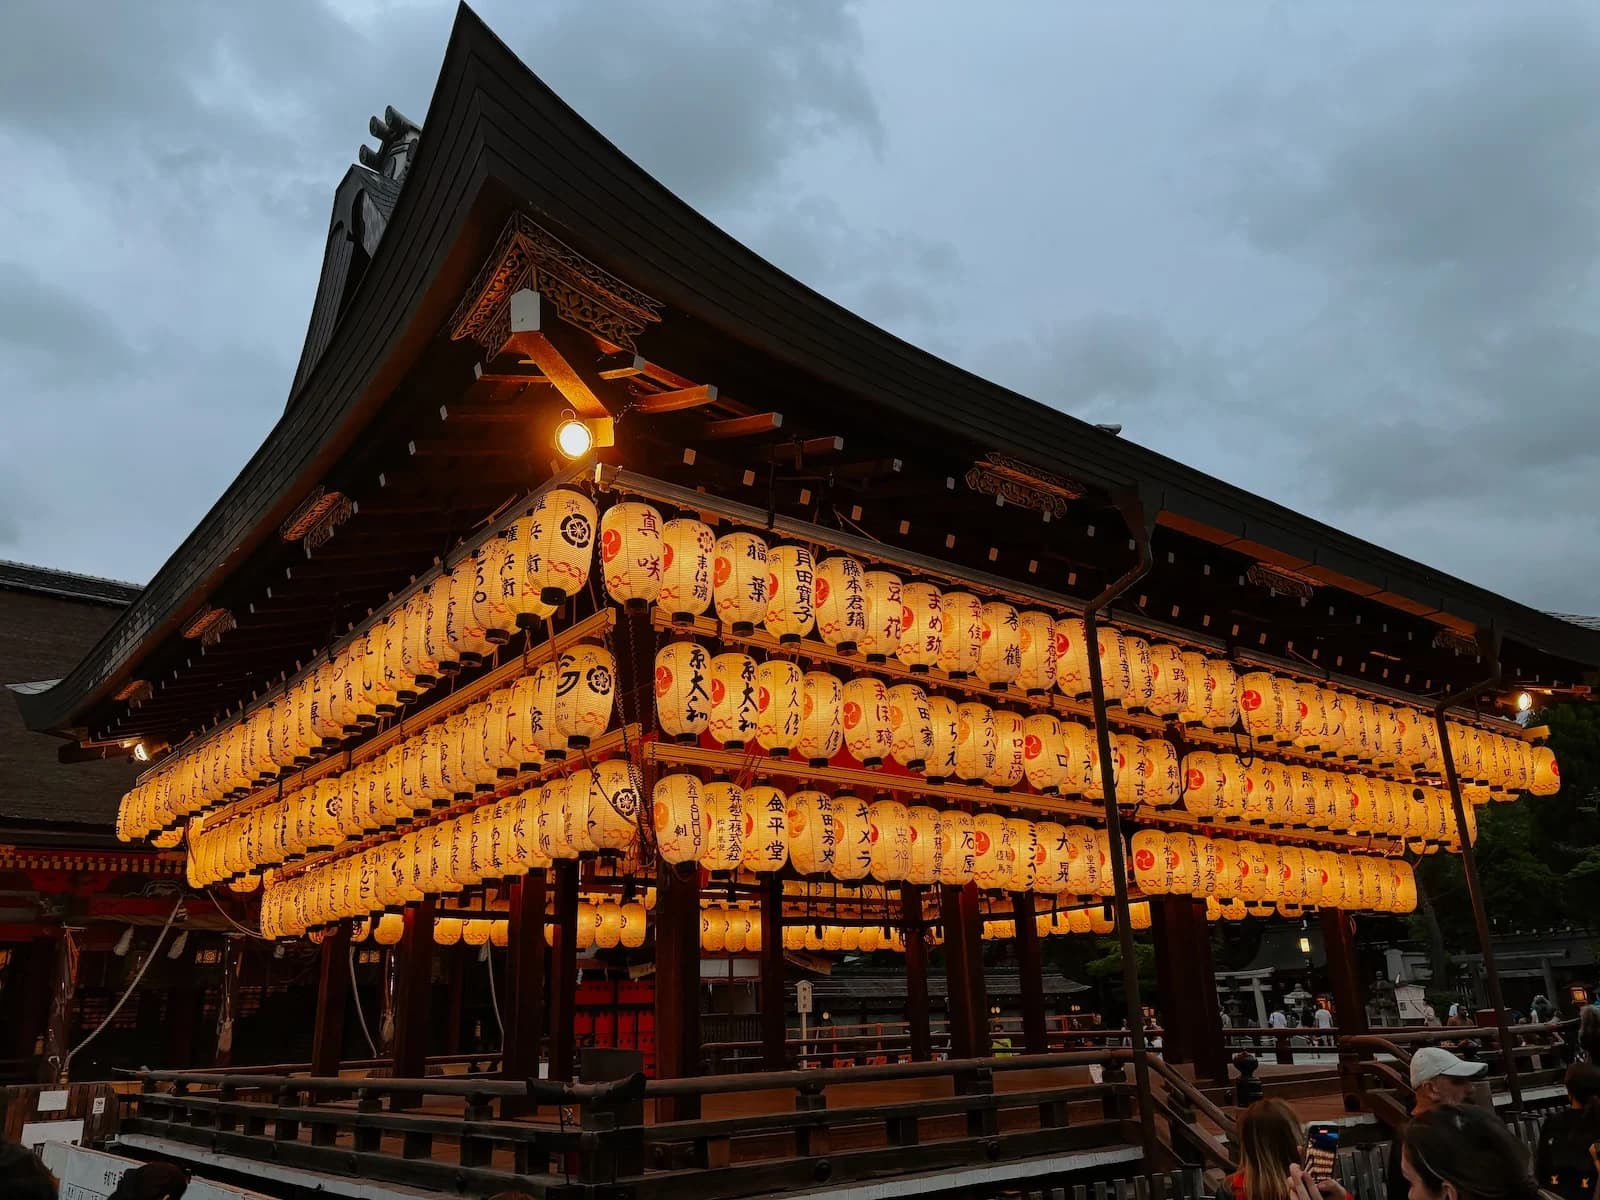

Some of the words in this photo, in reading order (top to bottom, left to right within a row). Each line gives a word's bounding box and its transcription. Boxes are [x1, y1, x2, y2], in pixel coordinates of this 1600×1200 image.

[637, 509, 661, 581] 真咲
[765, 793, 785, 862] 金平堂
[855, 803, 872, 867] キメラ
